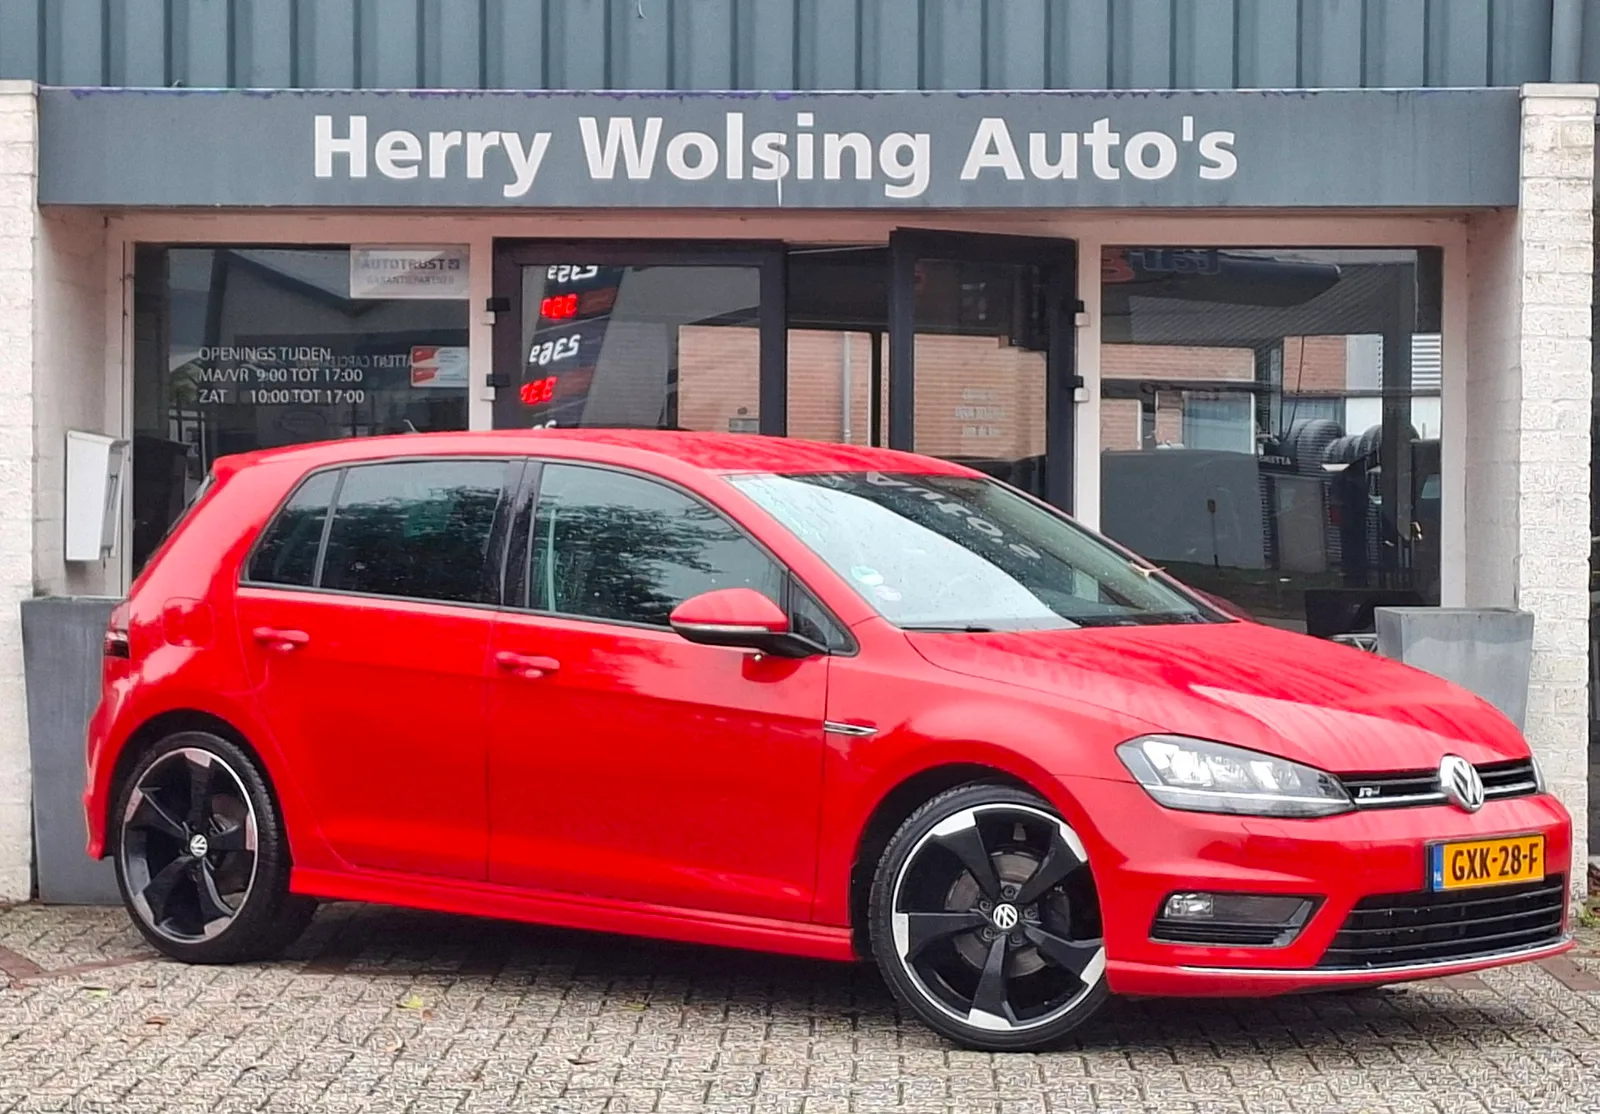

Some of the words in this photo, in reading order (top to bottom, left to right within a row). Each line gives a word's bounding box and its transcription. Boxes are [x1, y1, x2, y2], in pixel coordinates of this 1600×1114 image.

[314, 115, 552, 198] Herry
[578, 112, 931, 198] Wolsing
[960, 116, 1238, 181] Auto's
[199, 346, 276, 361] OPENINGS
[199, 368, 250, 382] MA/VR
[290, 368, 319, 382] TOT
[325, 368, 363, 382] 17:00
[199, 389, 229, 404] ZAT
[251, 389, 289, 404] 10:00
[291, 389, 321, 404] TOT
[1451, 842, 1539, 881] GXK-28-F
